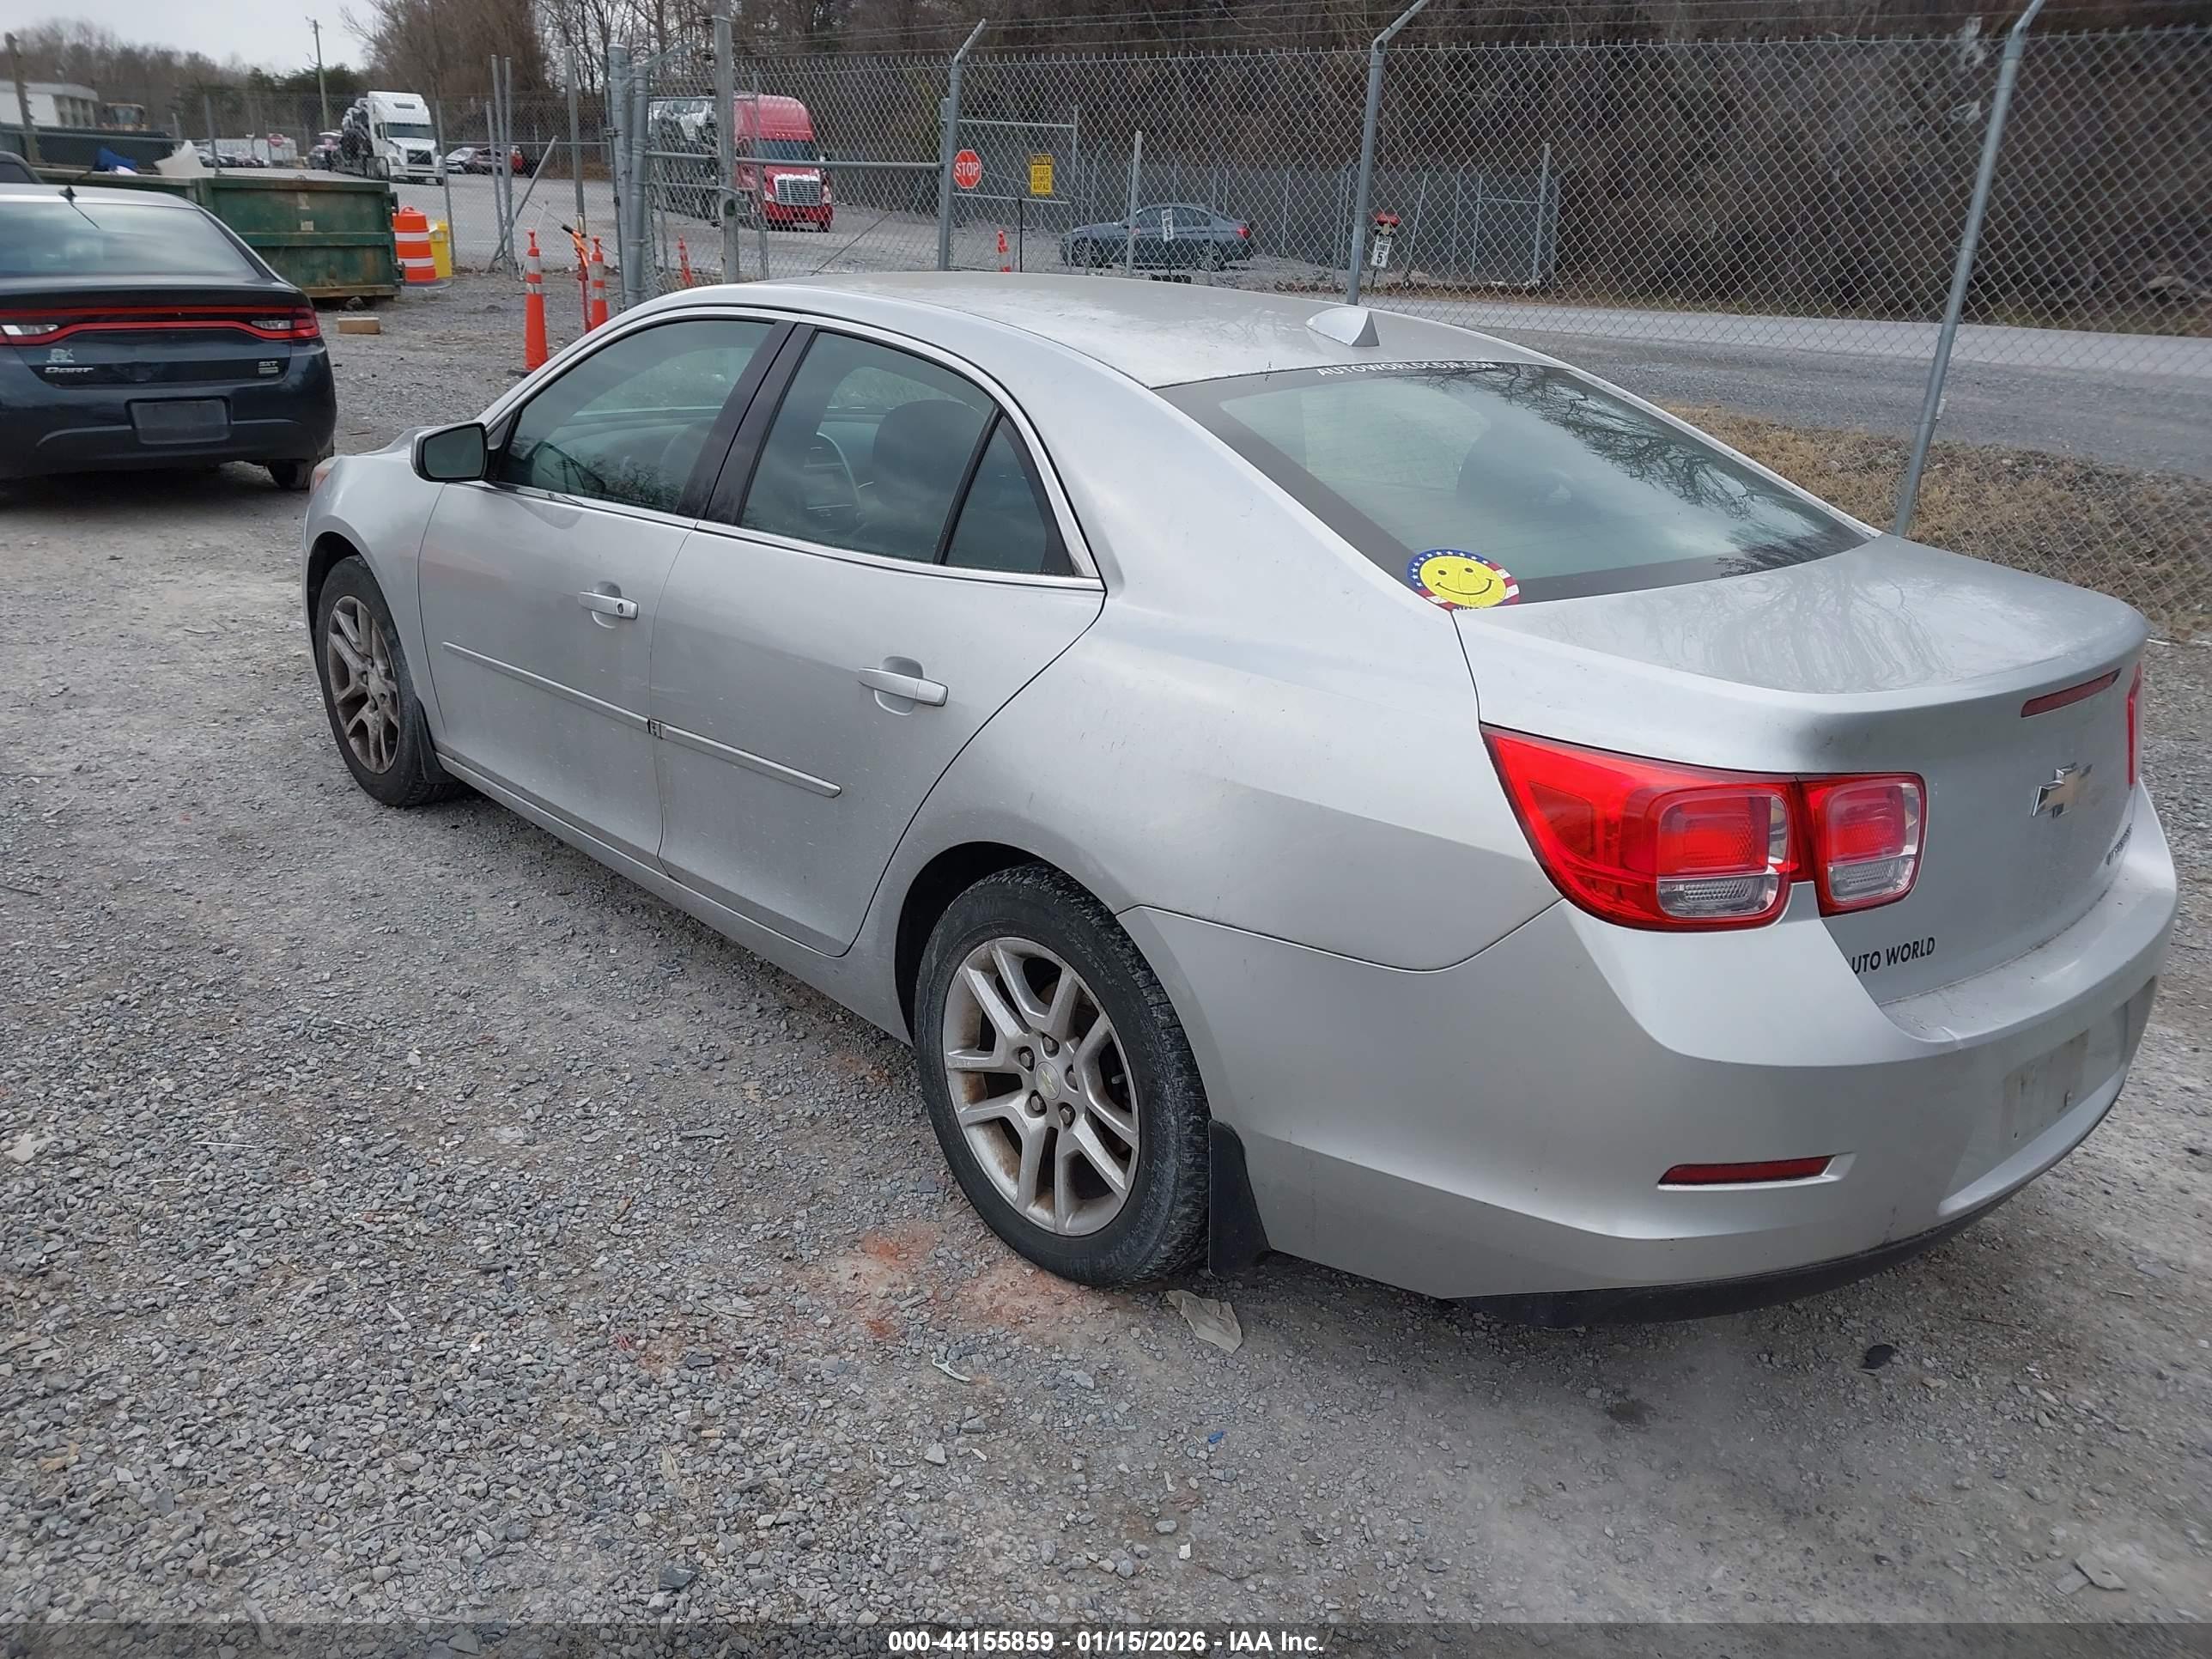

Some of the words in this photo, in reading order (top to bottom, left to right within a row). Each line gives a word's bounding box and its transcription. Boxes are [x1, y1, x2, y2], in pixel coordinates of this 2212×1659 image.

[955, 161, 979, 177] STOP
[1376, 252, 1383, 264] 5
[1852, 951, 1881, 975] UTO
[1886, 937, 1936, 966] WORLD
